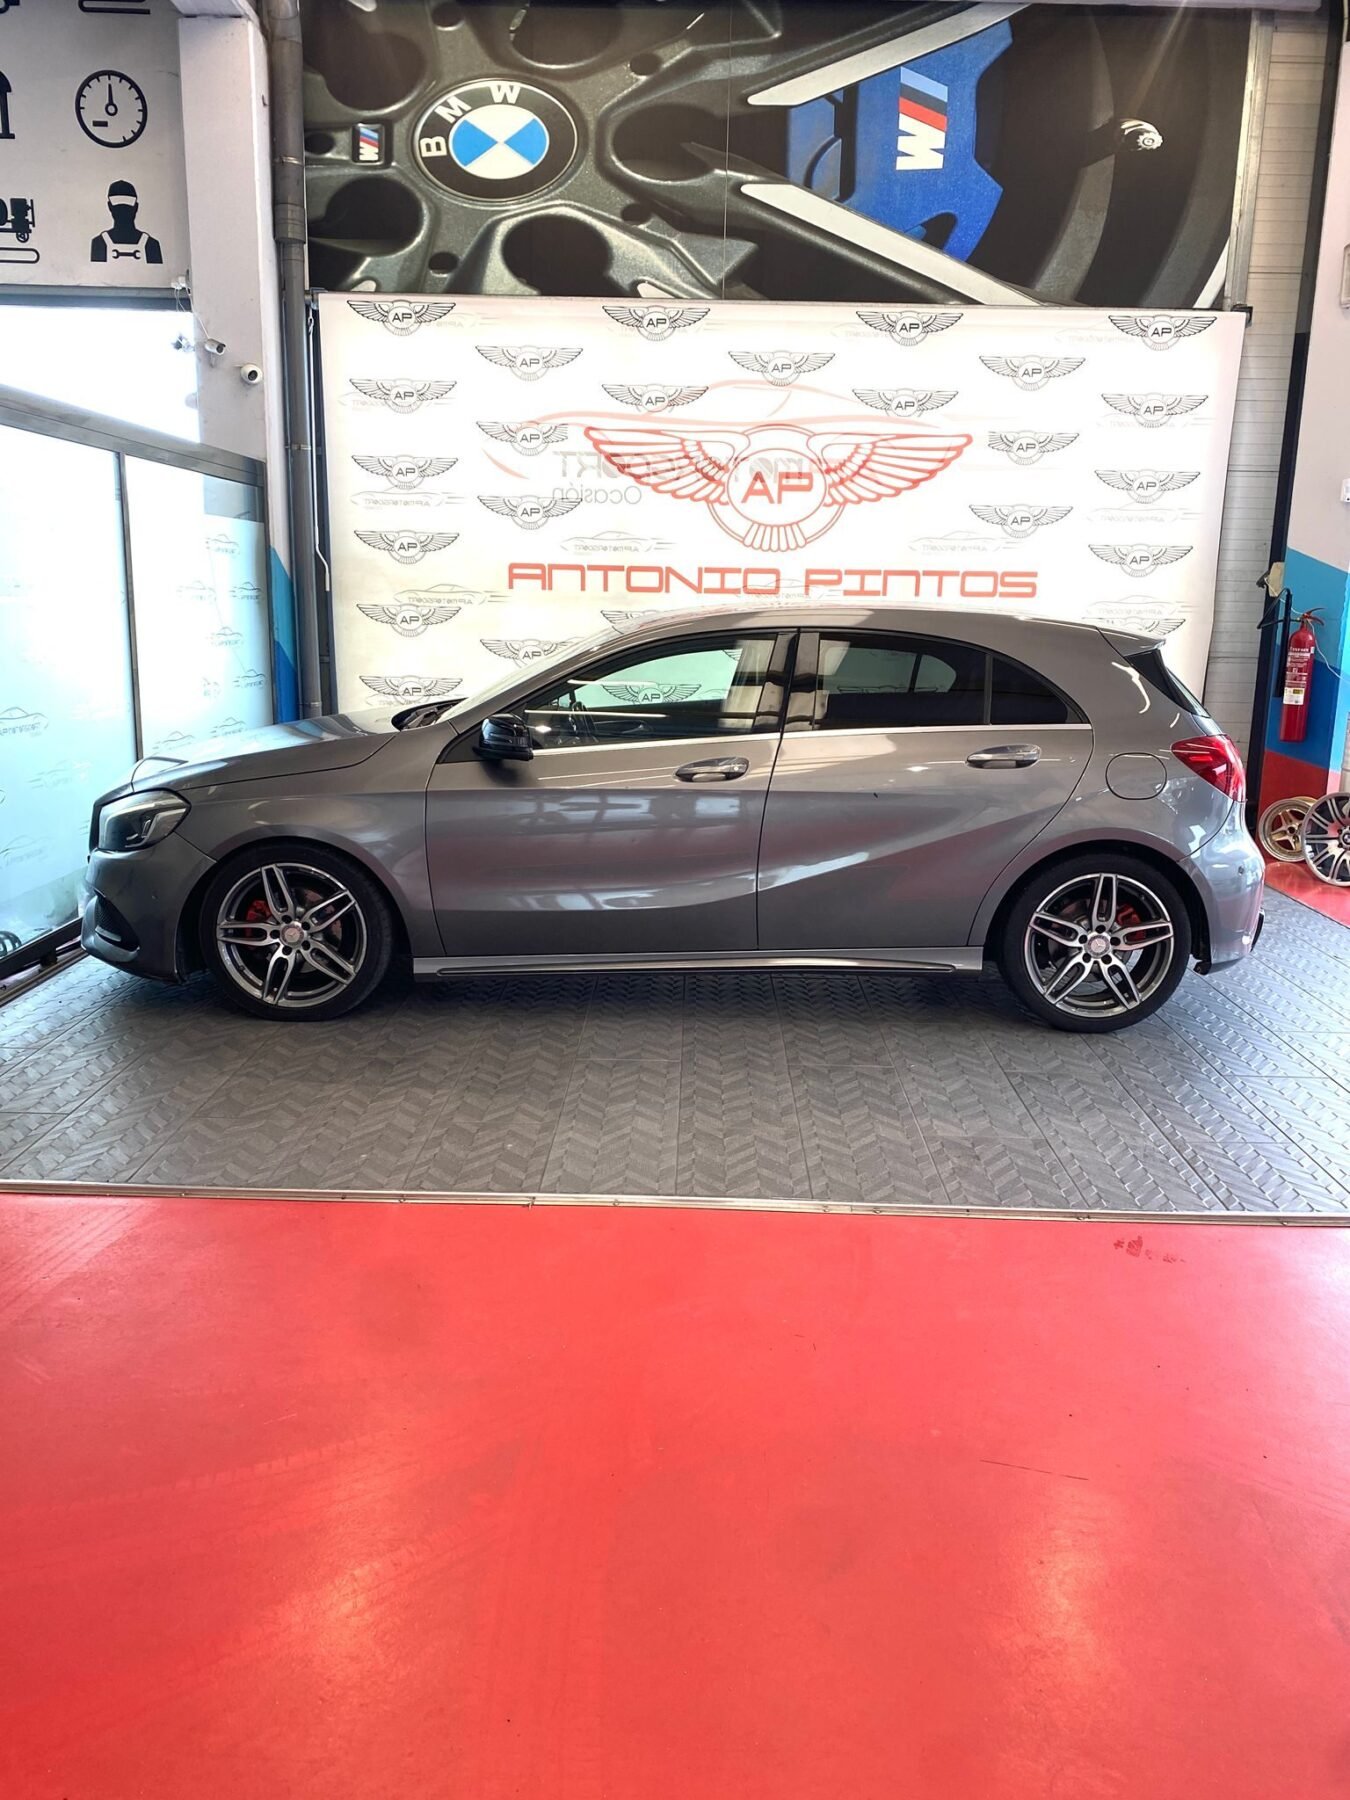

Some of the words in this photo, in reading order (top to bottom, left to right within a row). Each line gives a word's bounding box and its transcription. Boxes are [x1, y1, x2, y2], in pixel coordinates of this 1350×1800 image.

[419, 85, 521, 158] BMW
[391, 312, 413, 323] AP
[645, 317, 667, 328] AP
[898, 322, 920, 333] AP
[1150, 327, 1173, 337] AP
[520, 358, 541, 367] AP
[771, 363, 792, 373] AP
[1021, 367, 1042, 378] AP
[394, 391, 415, 400] AP
[645, 396, 666, 406] AP
[894, 401, 915, 410] AP
[1143, 405, 1164, 415] AP
[519, 433, 540, 443] AP
[1015, 442, 1037, 452] AP
[396, 467, 416, 477] AP
[741, 471, 814, 504] AP
[1136, 481, 1157, 491] AP
[520, 507, 541, 517] AP
[1010, 515, 1031, 526] AP
[397, 542, 418, 551] AP
[1129, 555, 1150, 565] AP
[507, 563, 780, 595] ANTONIO
[803, 569, 1038, 598] PINTOS
[400, 615, 420, 625] AP
[522, 650, 542, 660] AP
[401, 687, 422, 697] AP
[641, 693, 661, 702] AP
